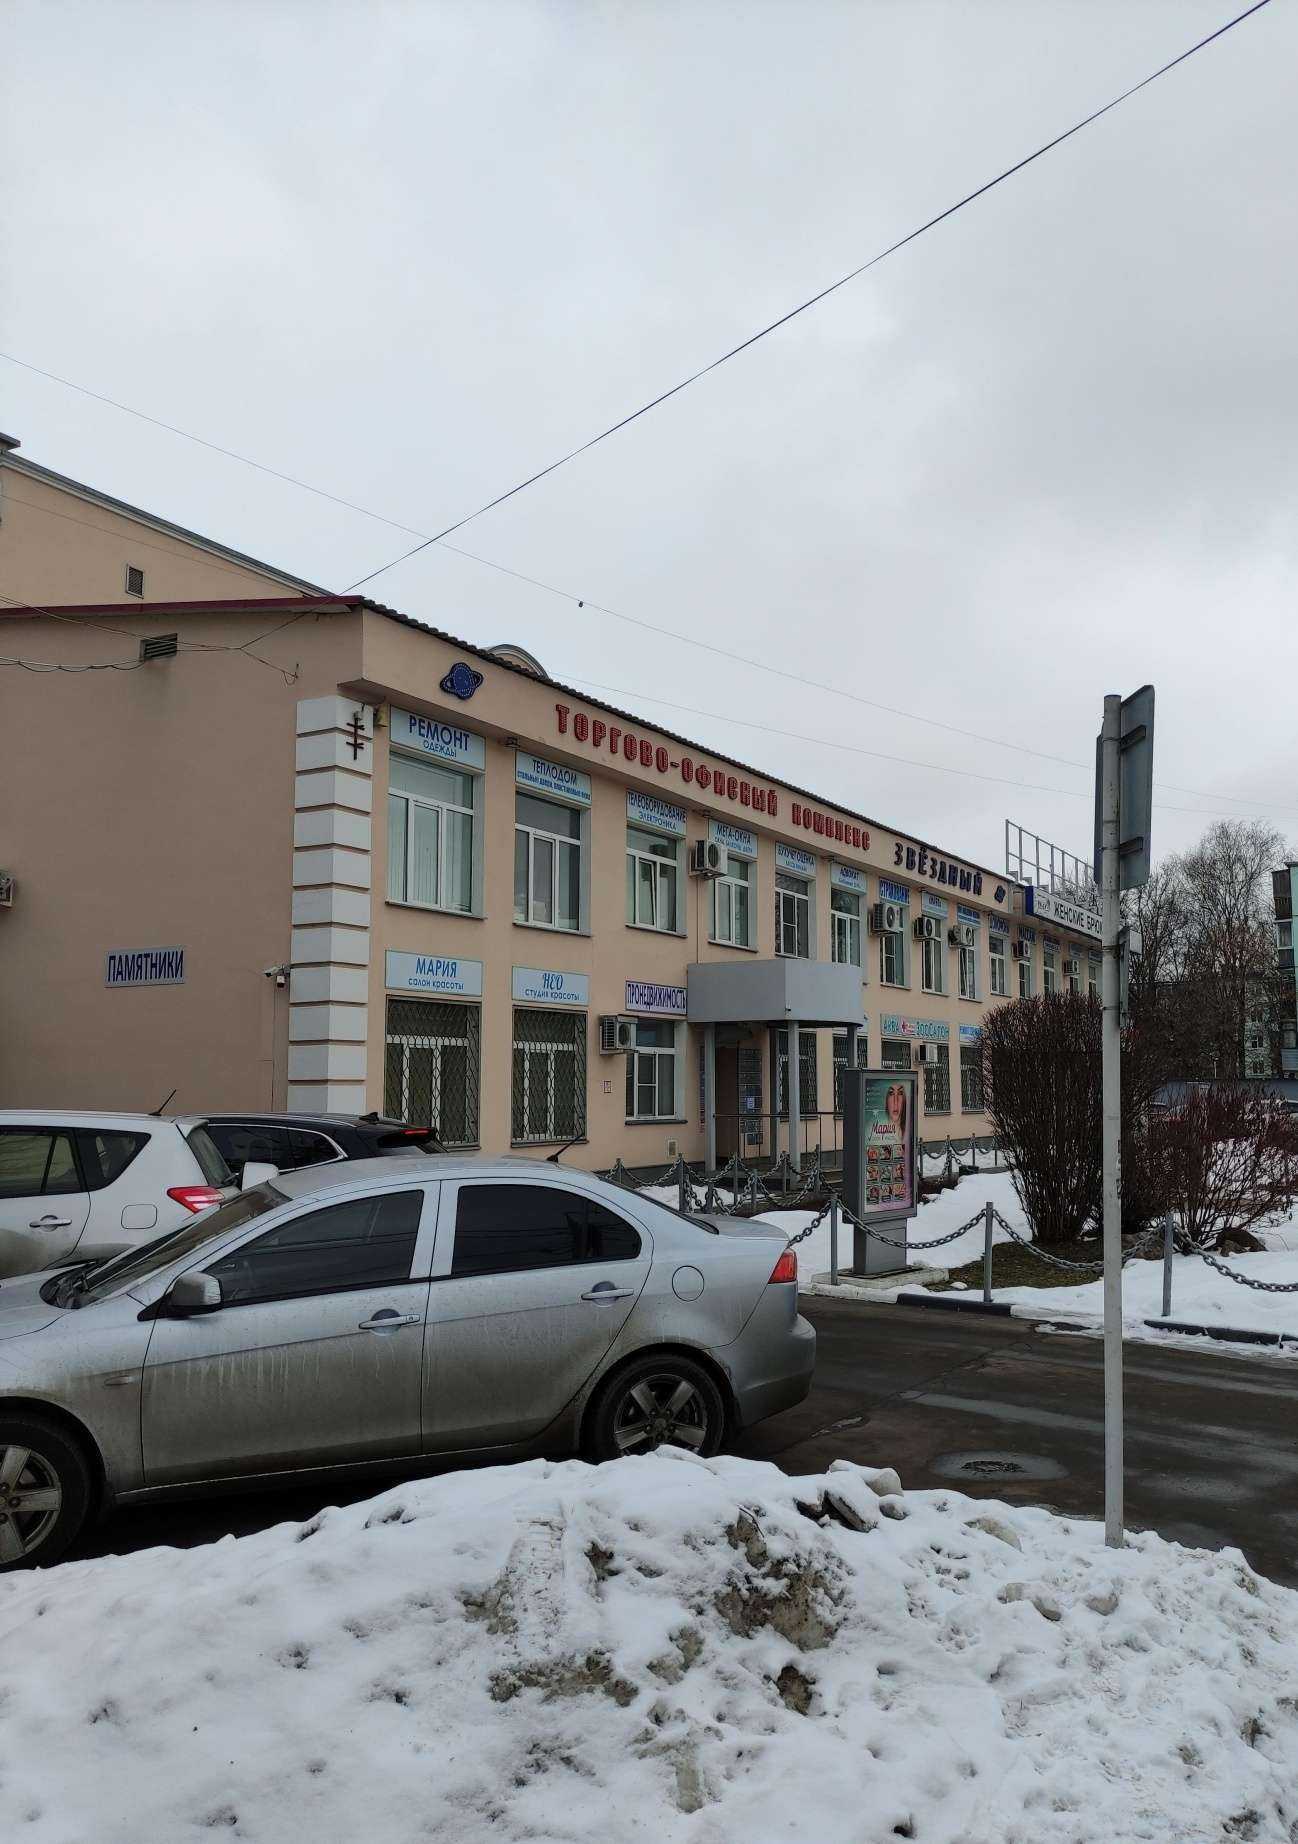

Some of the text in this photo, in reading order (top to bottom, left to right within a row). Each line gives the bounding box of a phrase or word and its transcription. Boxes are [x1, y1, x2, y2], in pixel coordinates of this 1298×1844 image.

[408, 714, 470, 752] РЕМОНТ
[423, 739, 457, 758] ОДЕЖДЫ
[532, 759, 577, 785] ТЕПЛОДОМ
[555, 703, 983, 896] ТОРГОВО-ОФИСНЫЙ КОМПЛЕКС ЗВЁЗДНЫЙ
[1053, 900, 1085, 928] ЖЕНСКИЕ
[107, 950, 184, 982] ПАМЯТНИКИ
[415, 957, 457, 978] МАРИЯ
